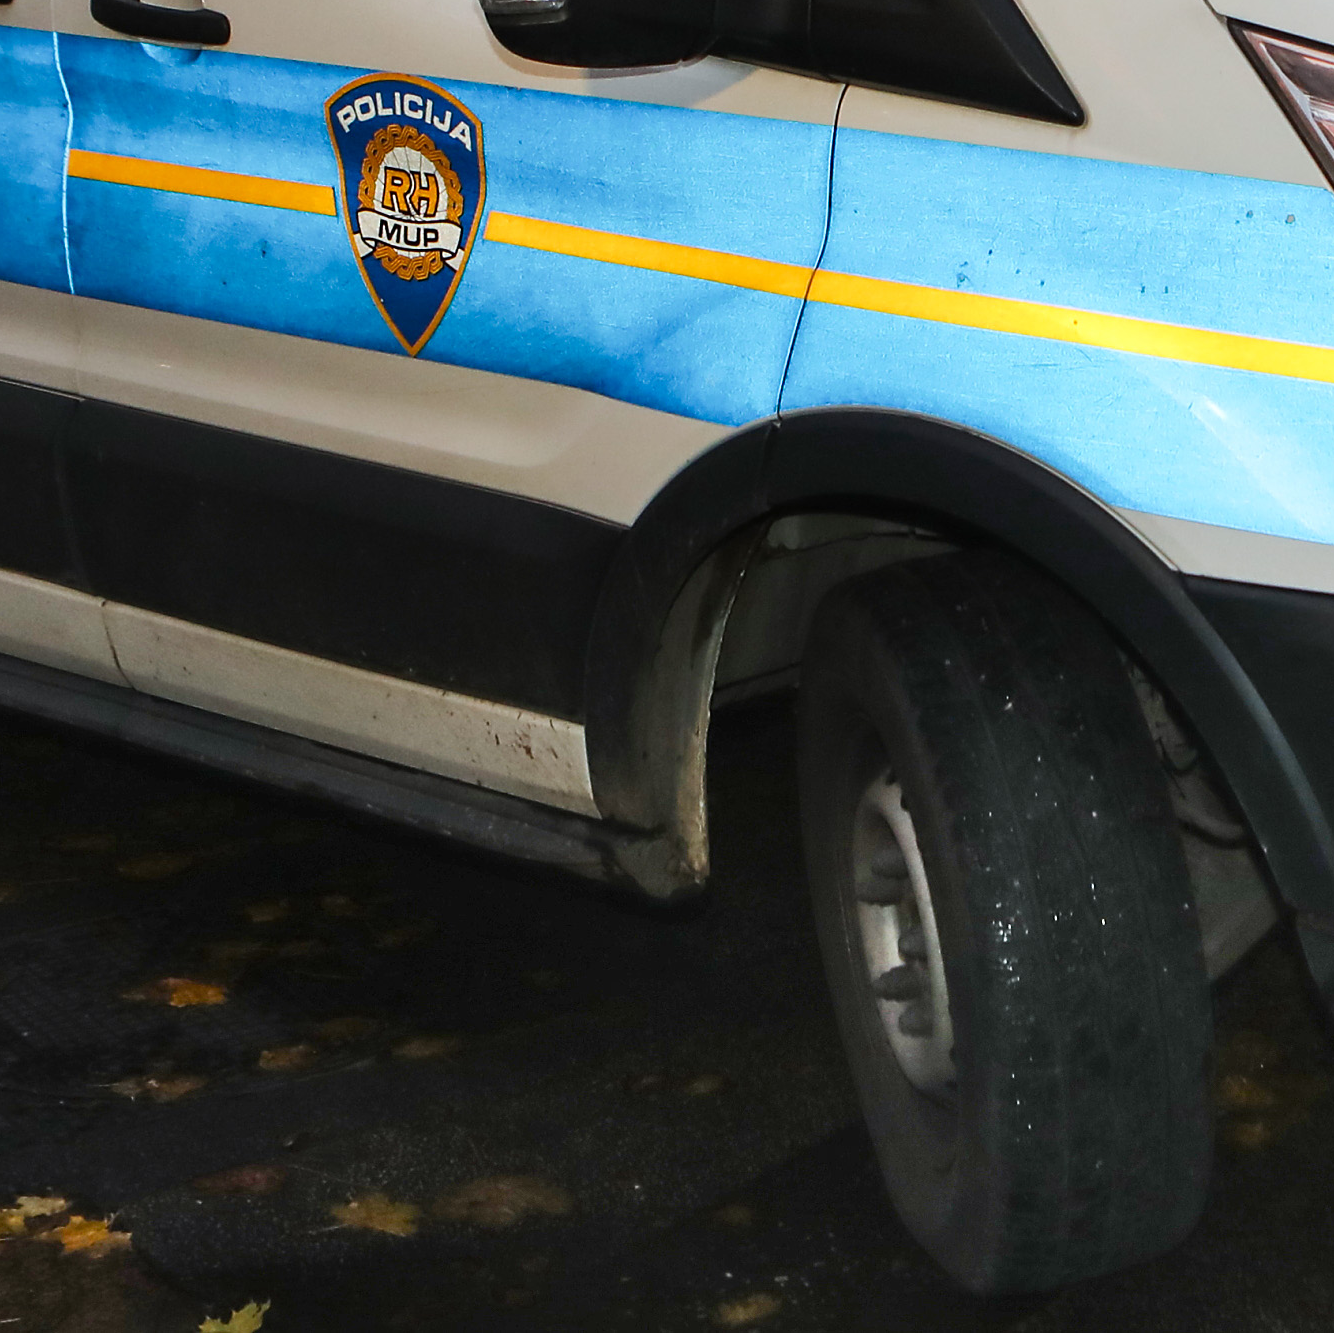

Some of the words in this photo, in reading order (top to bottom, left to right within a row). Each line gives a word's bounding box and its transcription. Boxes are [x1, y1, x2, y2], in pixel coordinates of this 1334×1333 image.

[336, 91, 472, 152] POLICIJA
[382, 166, 439, 217] RH
[378, 219, 439, 247] MUP
